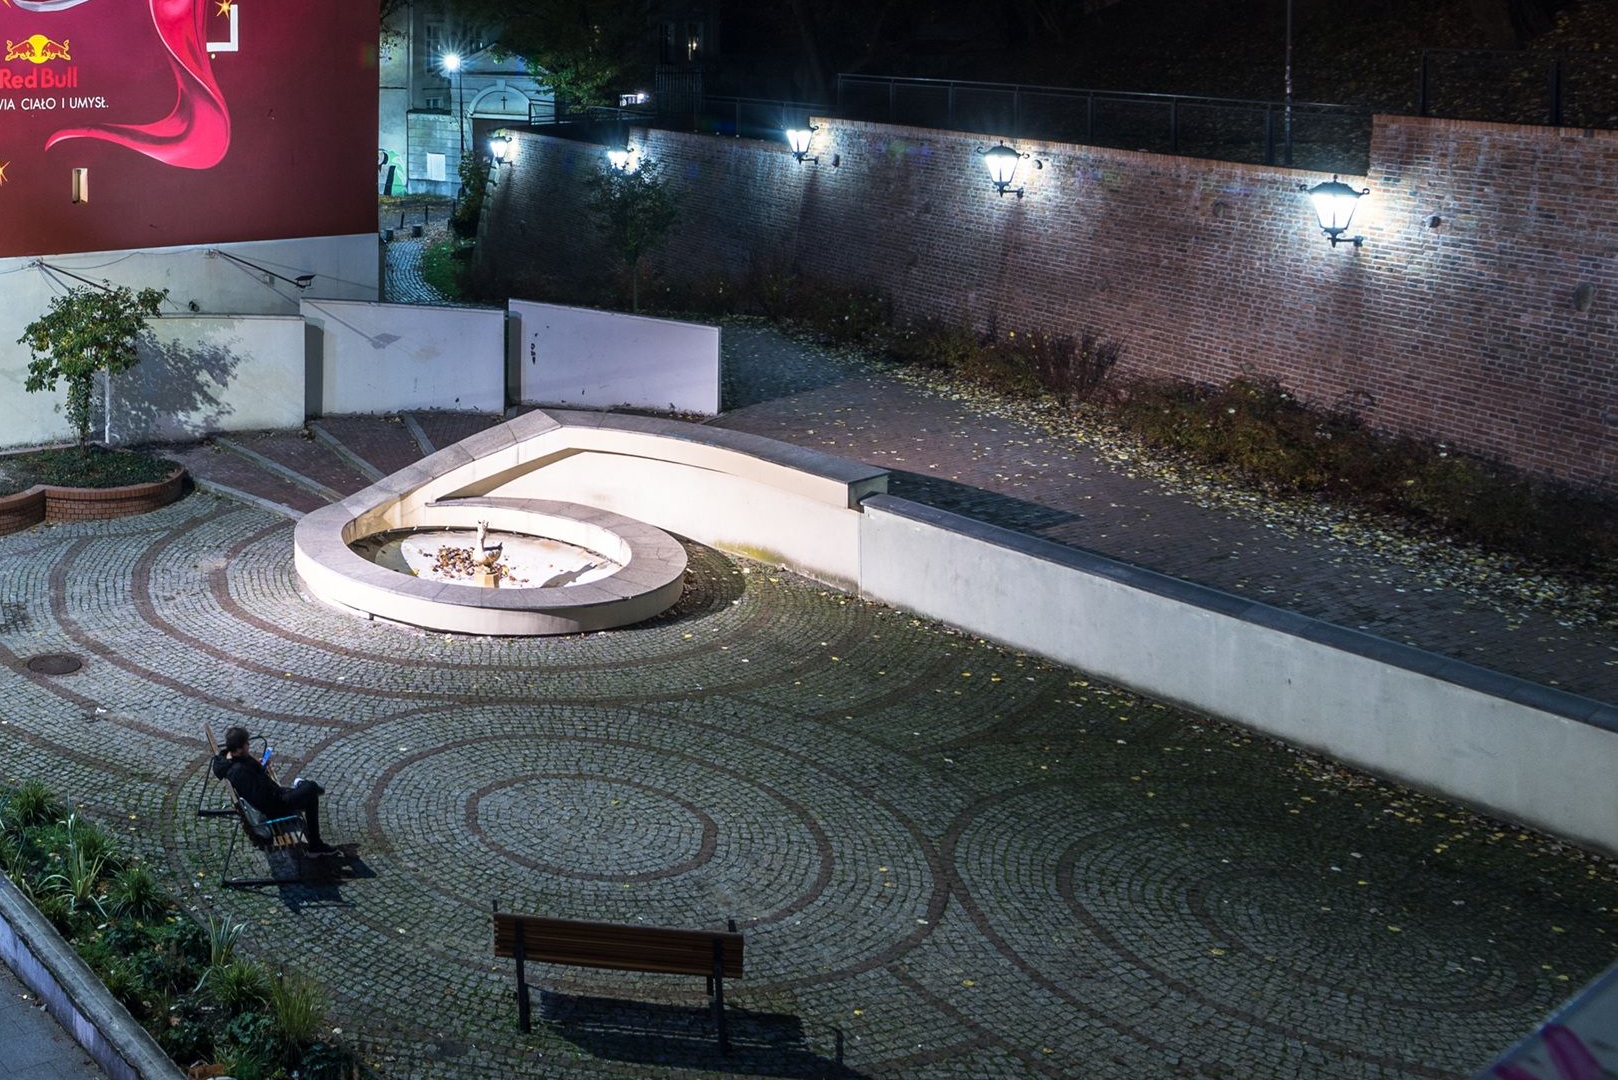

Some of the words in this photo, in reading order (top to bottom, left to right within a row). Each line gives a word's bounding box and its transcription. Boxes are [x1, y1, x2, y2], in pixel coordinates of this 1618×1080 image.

[41, 66, 78, 88] Bull
[21, 97, 57, 110] CIAŁO
[61, 98, 65, 109] I
[69, 96, 109, 109] UMYSŁ.
